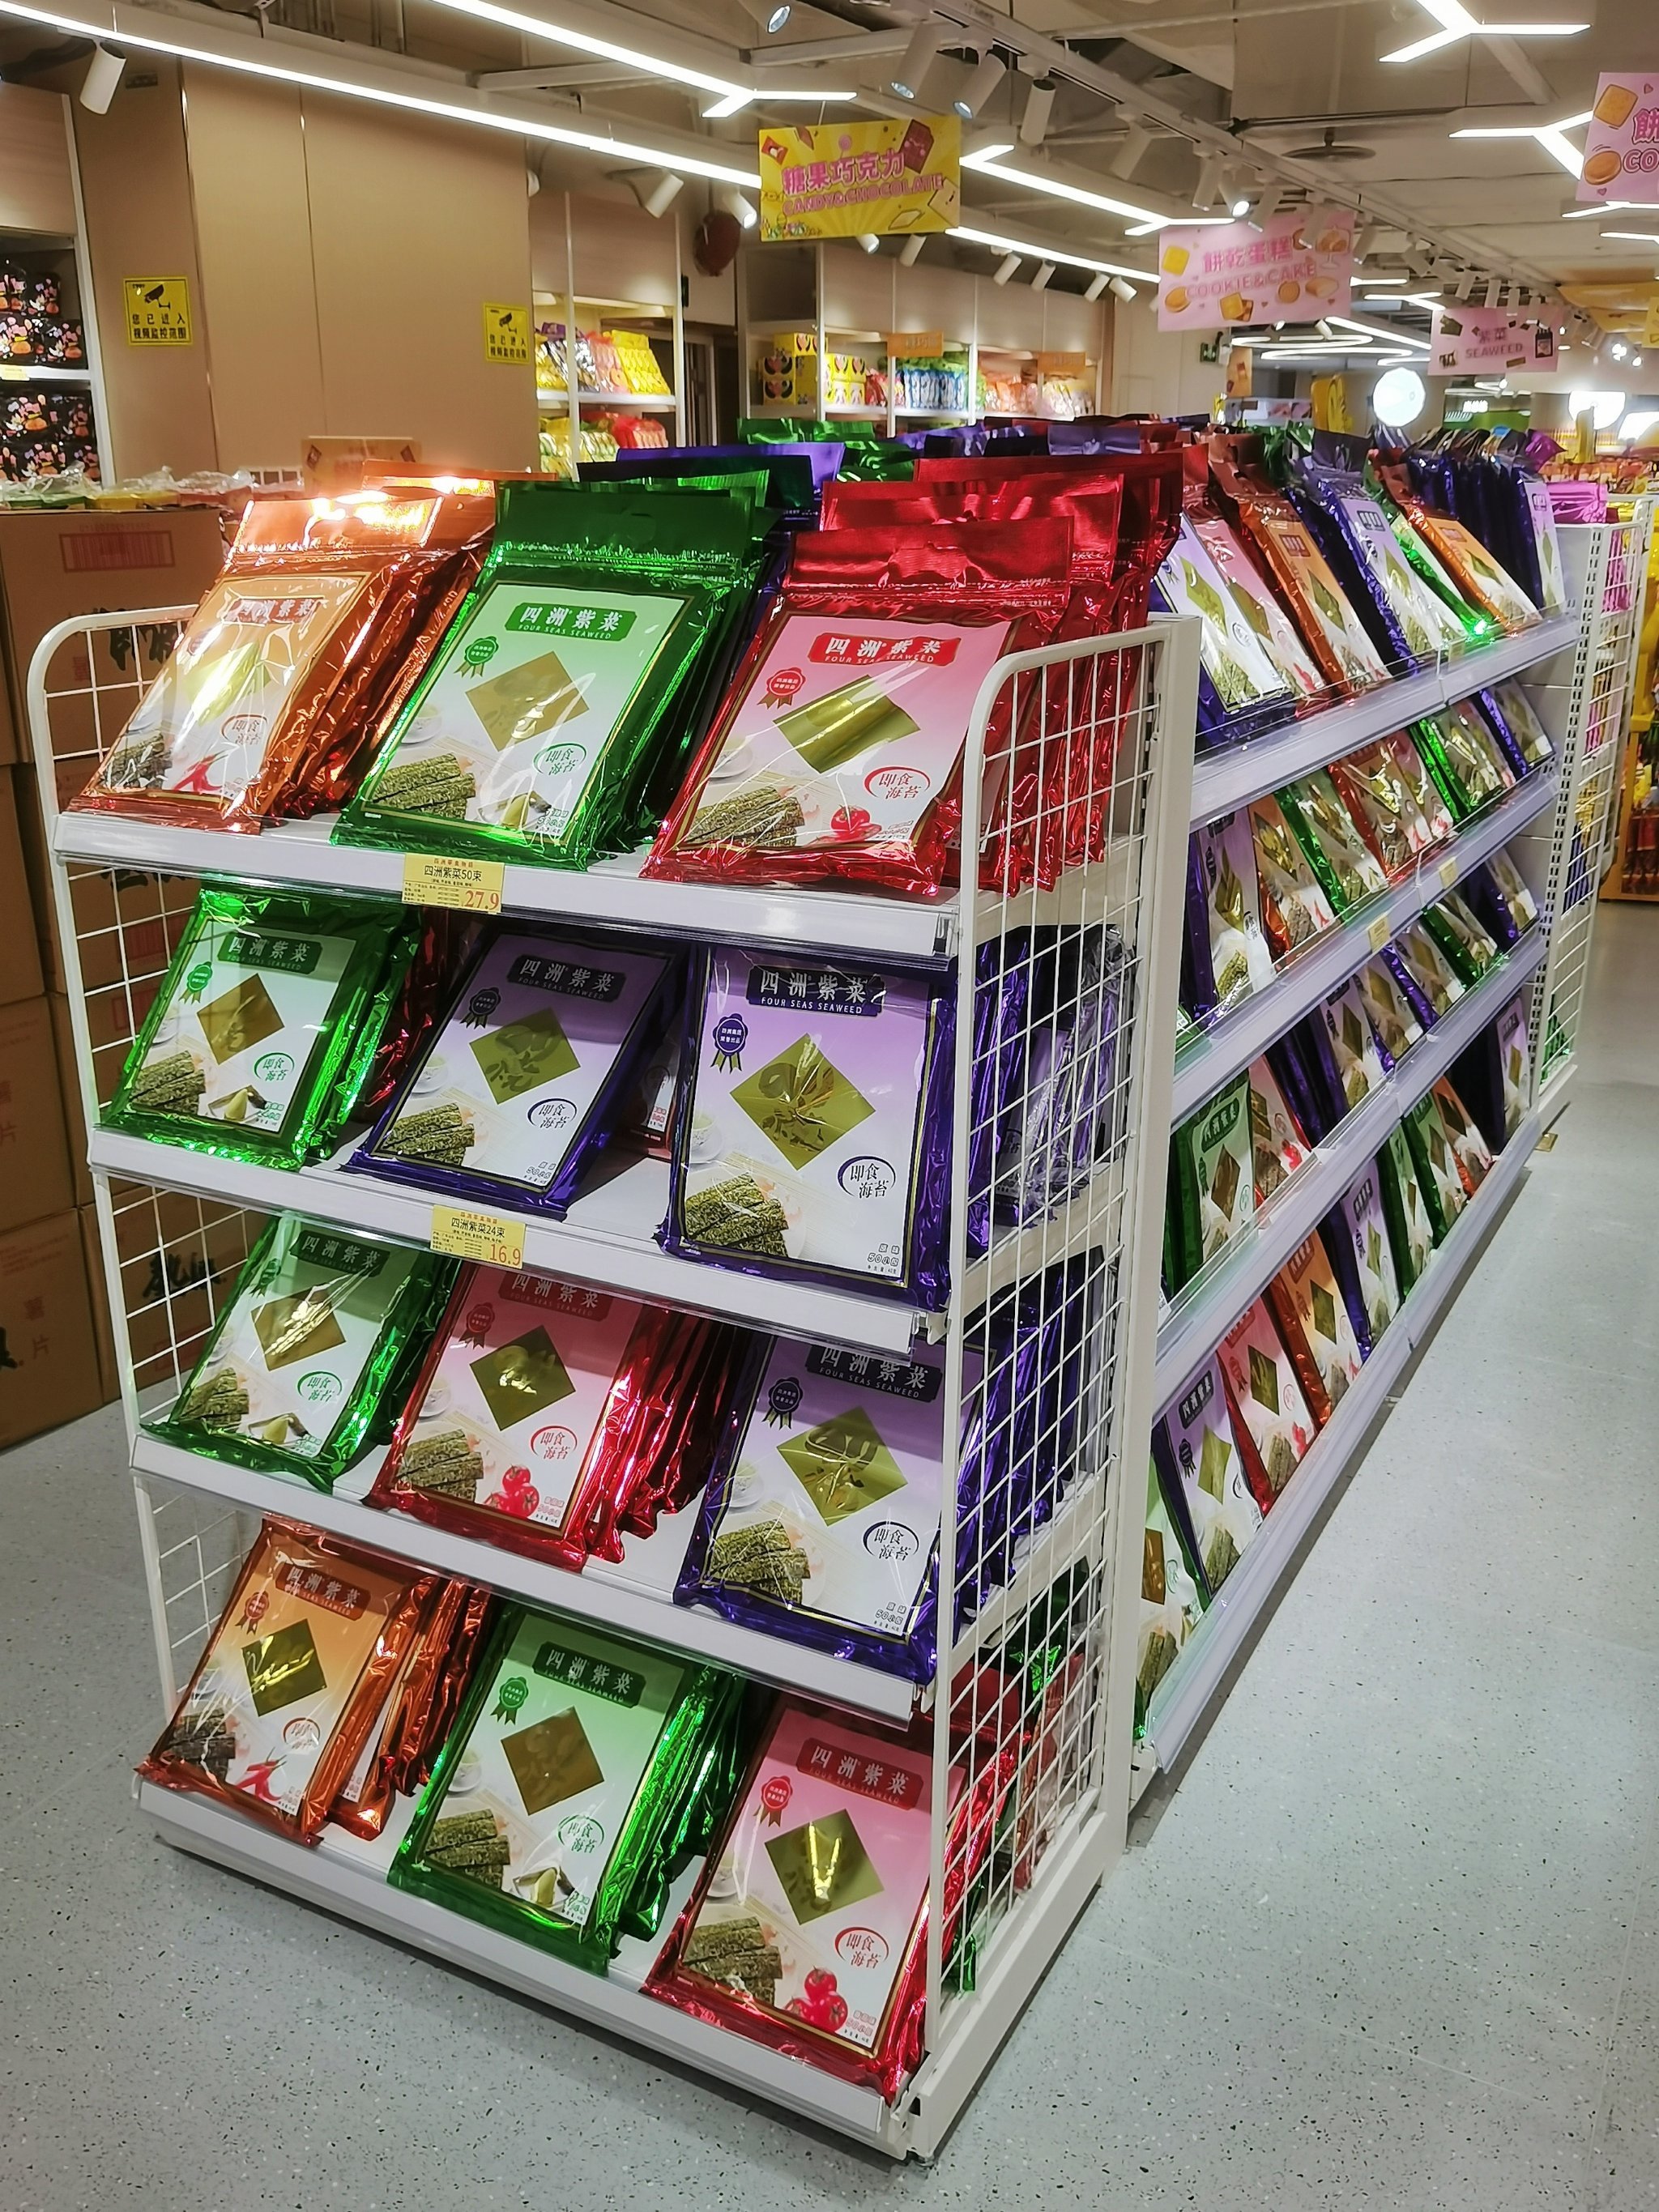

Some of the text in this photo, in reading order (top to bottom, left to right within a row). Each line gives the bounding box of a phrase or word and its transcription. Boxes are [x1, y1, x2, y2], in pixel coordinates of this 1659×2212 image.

[783, 149, 906, 197] 糖果巧克力
[1188, 261, 1317, 299] COOKIE&CAKE
[1465, 343, 1524, 359] SEAWEED
[519, 606, 624, 632] 四洲紫菜
[518, 624, 612, 640] FOUR SEAS SEAWEED
[825, 655, 852, 663] FOUR
[878, 773, 914, 787] 即食
[885, 785, 922, 800] 海苔
[464, 889, 500, 910] 27.9
[228, 936, 311, 963] 四洲紫菜
[519, 958, 616, 993] 四洲紫菜
[760, 970, 868, 1004] 四洲紫菜
[518, 977, 540, 986] FOUR
[566, 987, 605, 1000] SEAWEED
[761, 996, 864, 1015] FOUR SEAS SEAWEED
[850, 1163, 880, 1182] 即食
[859, 1179, 889, 1199] 海苔
[301, 1235, 381, 1269] 四洲紫菜
[489, 1242, 522, 1266] 16.9
[820, 1347, 928, 1390] 四洲紫菜
[820, 1367, 919, 1399] FOUR SEAS SEAWEED
[546, 1649, 634, 1694] 四洲紫菜
[810, 1745, 910, 1796] 四洲紫菜
